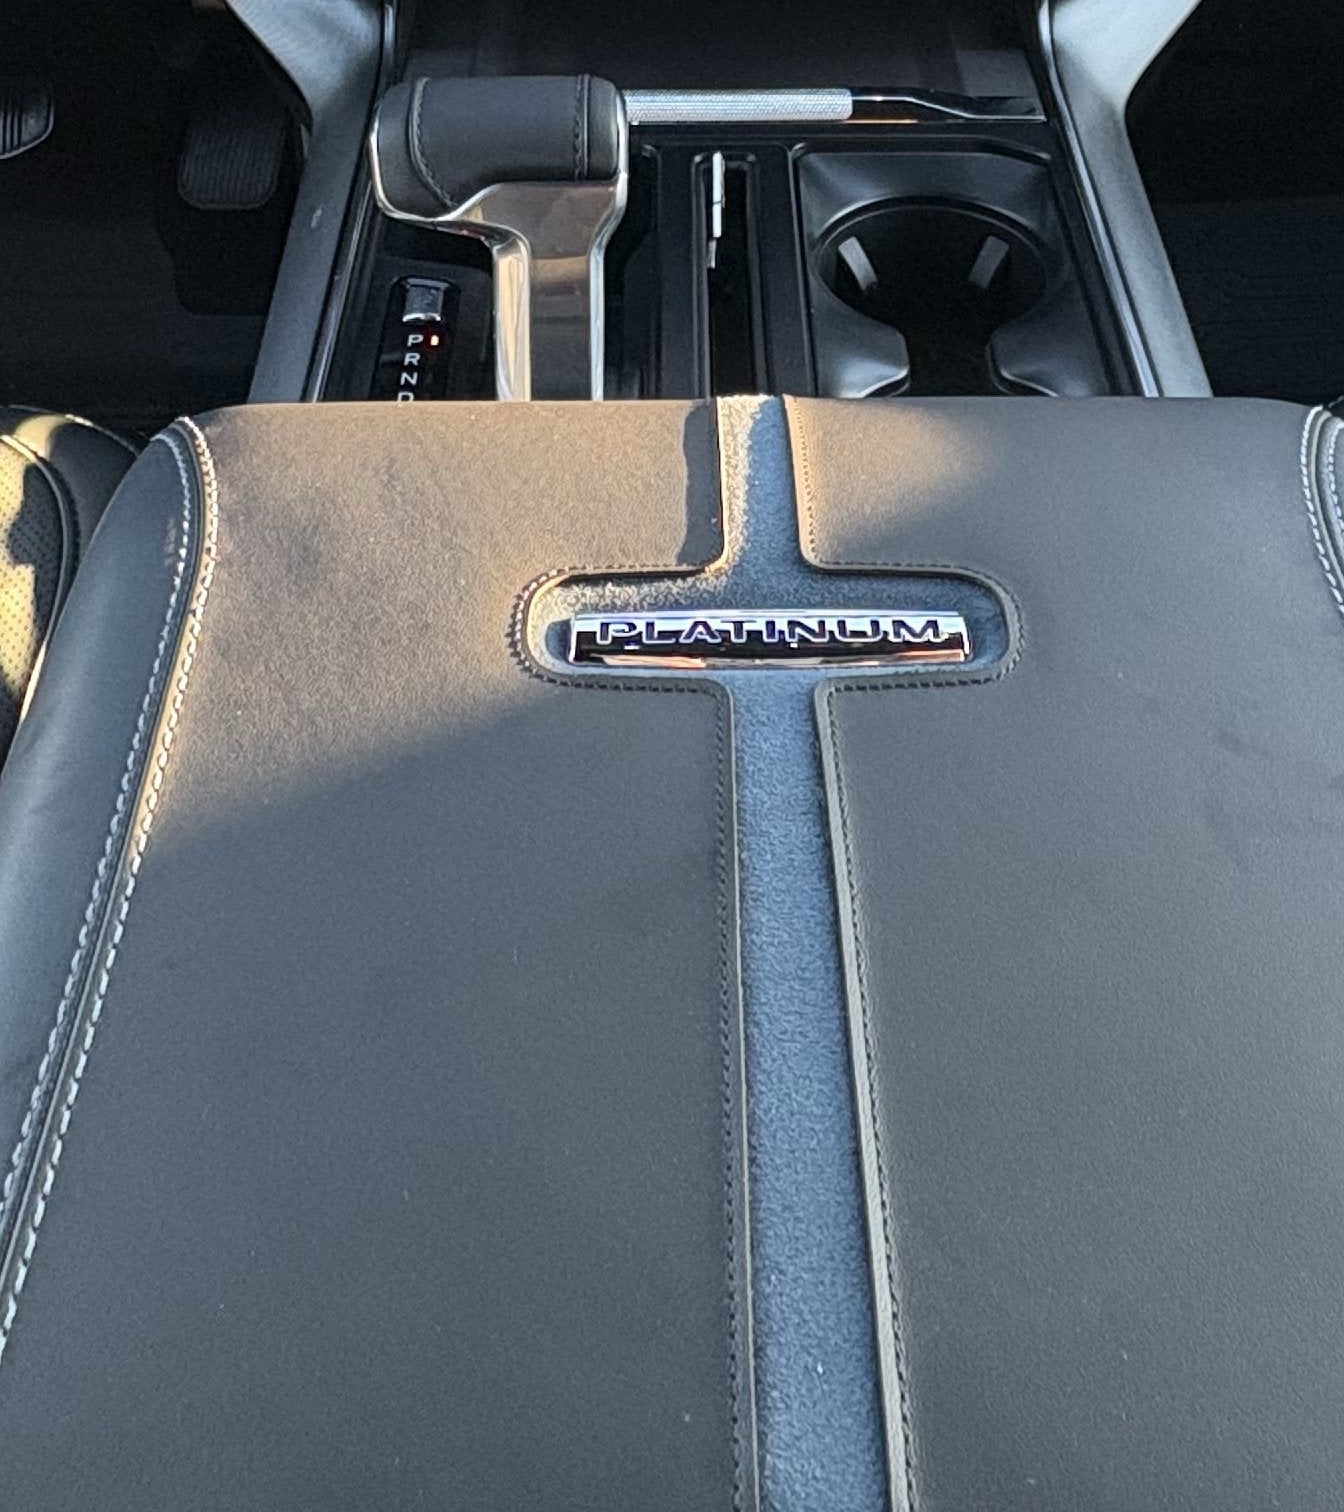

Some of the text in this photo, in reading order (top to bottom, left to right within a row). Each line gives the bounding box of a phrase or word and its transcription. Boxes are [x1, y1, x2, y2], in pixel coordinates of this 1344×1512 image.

[406, 334, 425, 348] P
[403, 352, 421, 366] R
[399, 371, 418, 386] N
[596, 618, 949, 645] PLATINUM
